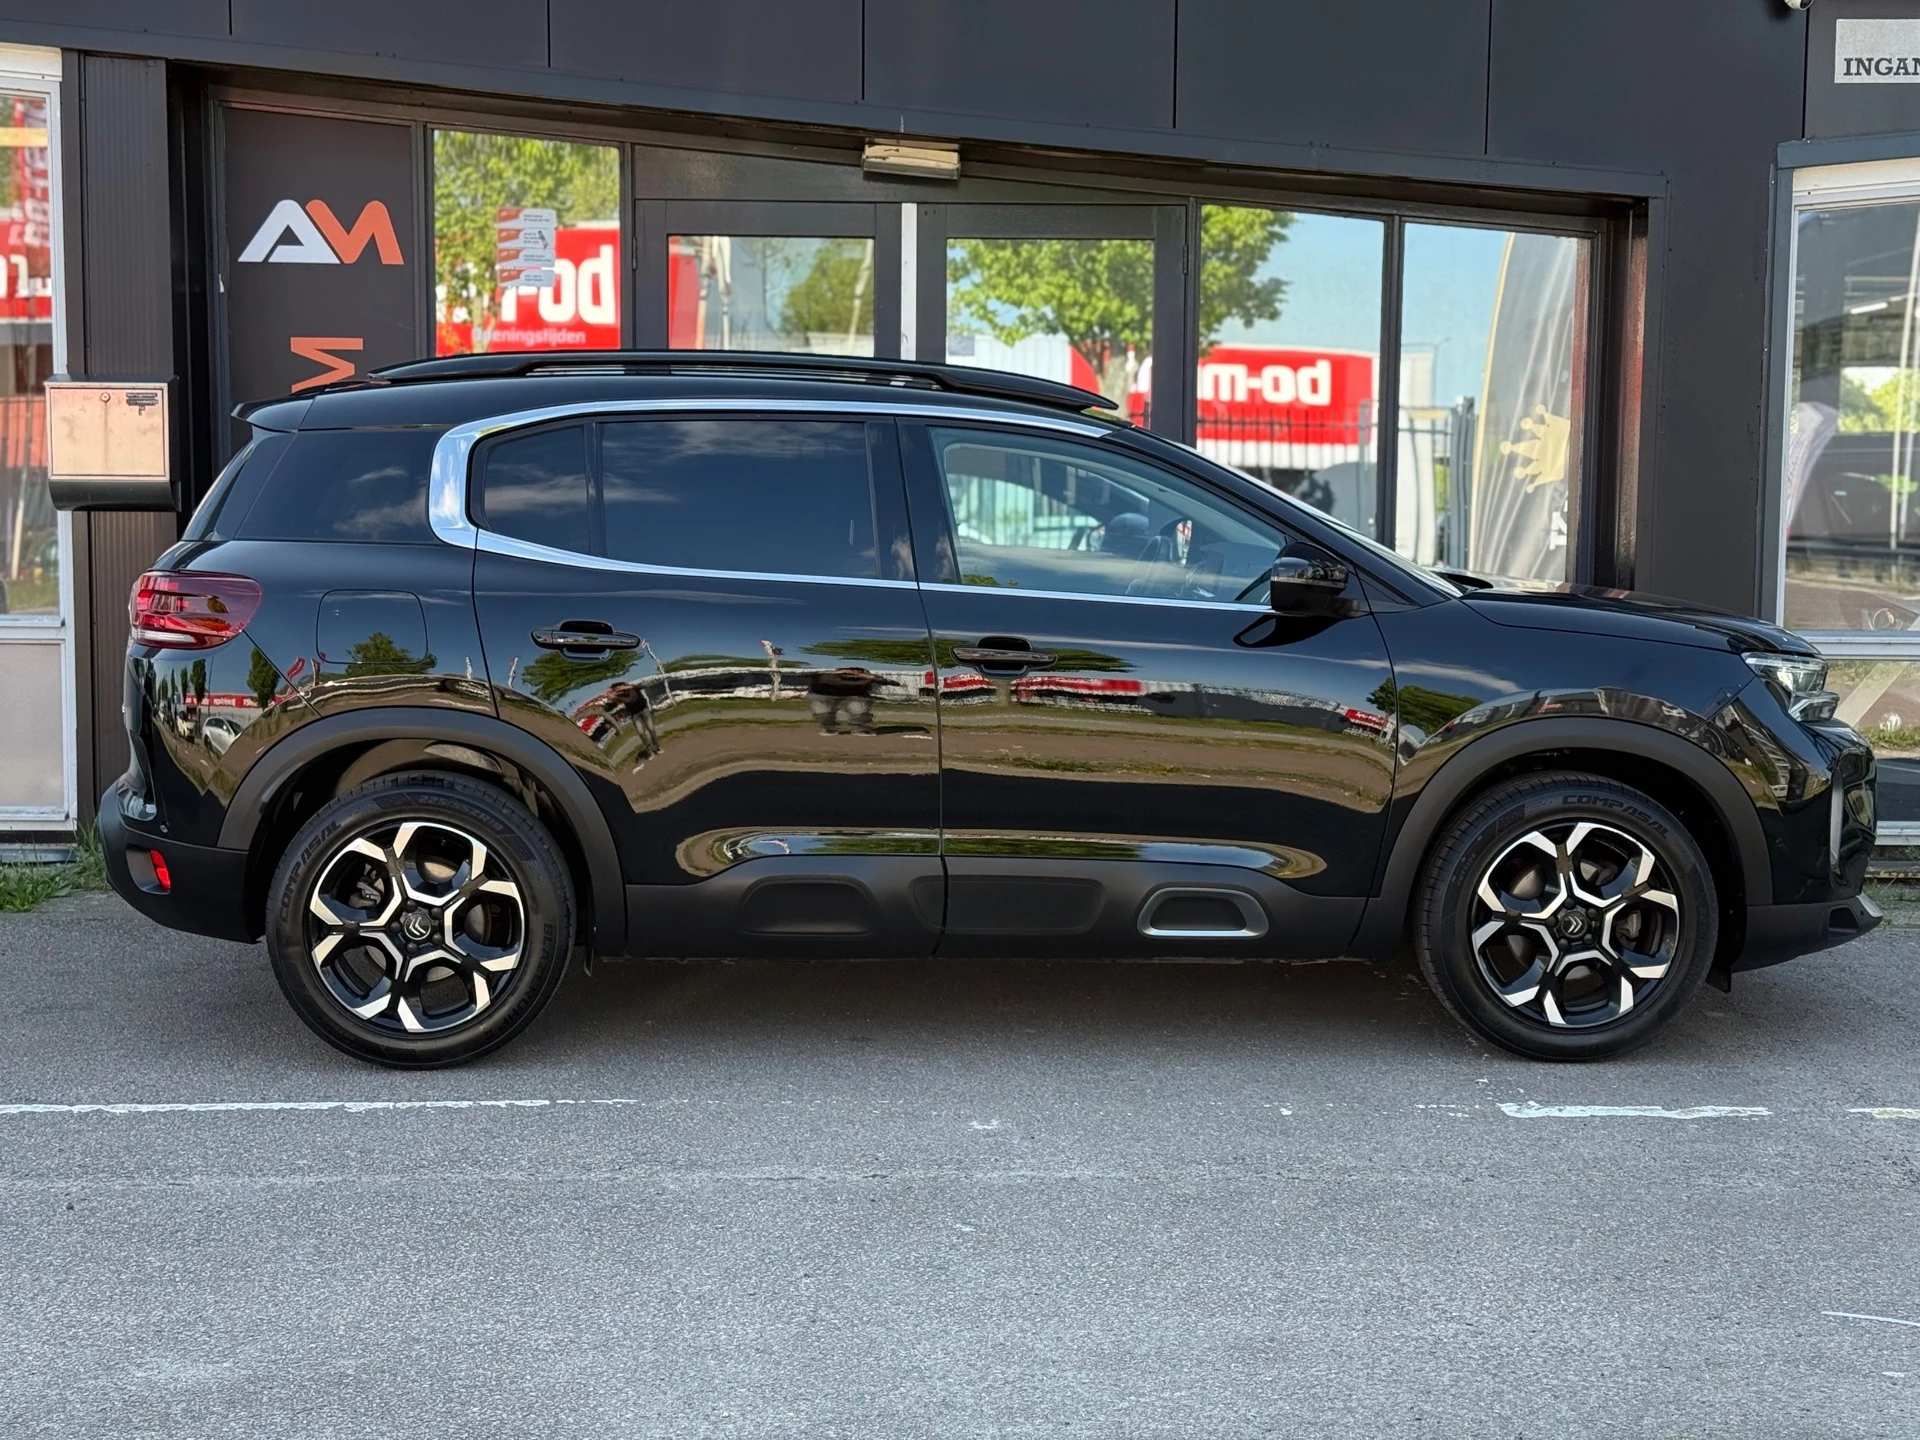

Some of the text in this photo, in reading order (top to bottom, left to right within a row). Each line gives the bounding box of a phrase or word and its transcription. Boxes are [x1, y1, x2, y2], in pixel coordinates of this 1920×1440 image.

[237, 199, 404, 265] AM
[1562, 794, 1670, 839] COMPASAL
[279, 818, 342, 924] COMPASAL
